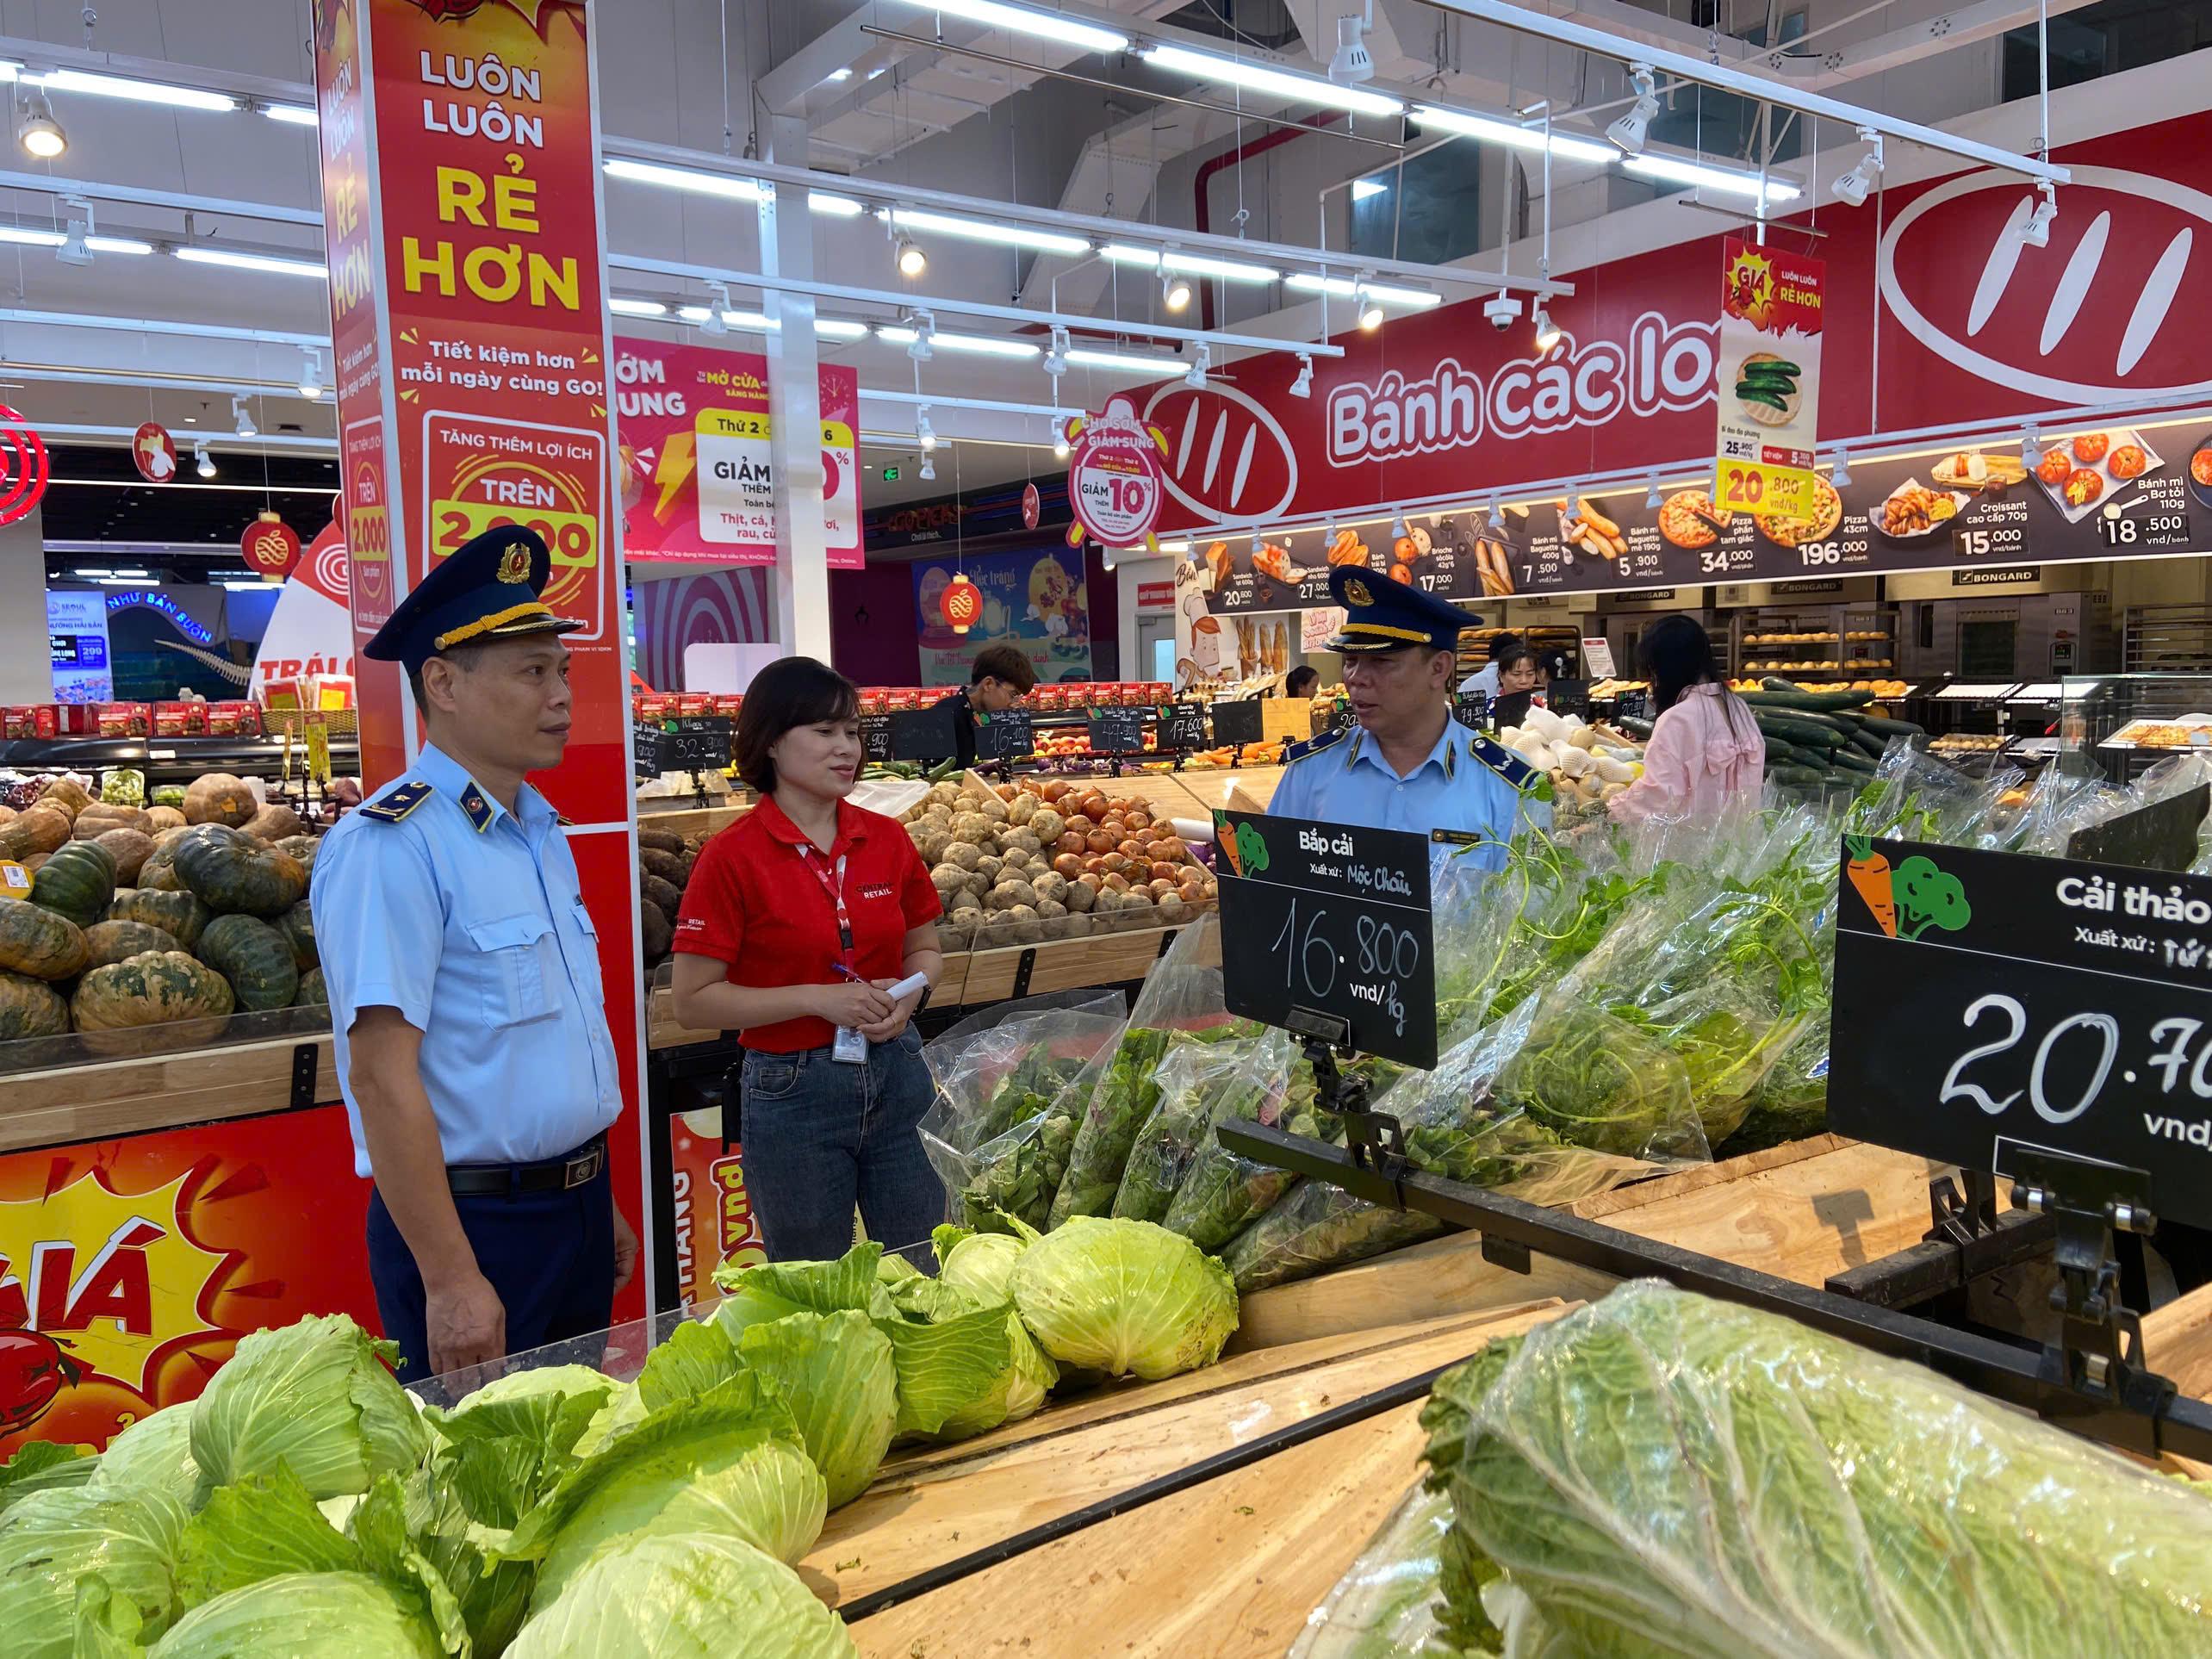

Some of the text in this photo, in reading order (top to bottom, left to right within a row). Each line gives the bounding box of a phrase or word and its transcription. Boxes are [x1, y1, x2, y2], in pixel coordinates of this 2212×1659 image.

[327, 55, 352, 116] LUÔN
[419, 49, 542, 103] LUÔN
[422, 99, 544, 148] LUÔN
[437, 152, 540, 233] RẺ
[332, 239, 371, 322] HƠN
[402, 236, 580, 311] HƠN
[1781, 270, 1817, 286] LUÔN LUÔN
[1780, 283, 1821, 309] RẺ HƠN
[429, 340, 575, 370] Tiết kiệm hơn
[401, 362, 604, 397] mỗi ngày cùng GO!
[615, 352, 666, 384] ỚM
[706, 369, 761, 389] MỞ CỬA
[1333, 326, 1712, 457] Bánh các lo
[616, 392, 686, 418] UNG
[717, 418, 745, 433] Thứ
[750, 422, 759, 433] 2
[824, 430, 833, 441] 6
[1112, 414, 1141, 430] SỚM
[439, 429, 593, 460] TĂNG THÊM LỢI ÍCH
[1088, 432, 1155, 449] GIẢM SUNG
[714, 456, 771, 482] GIẢM
[358, 478, 376, 503] TRÊN
[480, 478, 555, 507] TRÊN
[742, 484, 771, 494] THÊM
[1082, 482, 1109, 497] GIẢM
[2138, 475, 2184, 489] Bánh mì
[2150, 486, 2185, 499] Bơ tỏi
[744, 499, 764, 507] Toàn
[1770, 498, 1799, 514] vnd/kg
[1980, 500, 2027, 512] Croissant
[2160, 499, 2185, 510] 110g
[720, 513, 748, 526] Thịt,
[751, 515, 768, 527] cá,
[1731, 517, 1753, 526] Pizza
[1844, 515, 1867, 525] Pizza
[1967, 509, 2028, 525] cao cấp 70g
[353, 514, 387, 553] 2.000
[438, 510, 592, 559] 200
[737, 529, 760, 541] rau,
[1628, 536, 1661, 544] Baguette
[1631, 527, 1649, 536] Bánh
[1720, 534, 1755, 544] tam giác
[1960, 529, 2022, 556] 15.000
[1530, 545, 1559, 554] Baguette
[1798, 540, 1867, 566] 196.000
[1700, 550, 1754, 573] 34.000
[1788, 582, 1836, 592] BONGARD
[1973, 571, 2032, 583] BONGARD
[108, 591, 141, 610] NHƯ
[176, 612, 213, 643] BUÔN
[260, 651, 338, 680] TRÁI
[1299, 827, 1354, 856] Bắp cải
[1309, 862, 1327, 876] Xuất
[1347, 865, 1373, 894] Mộc
[864, 888, 892, 899] RETAIL
[2055, 874, 2212, 925] Cải thảo
[2074, 926, 2118, 948] Xuất
